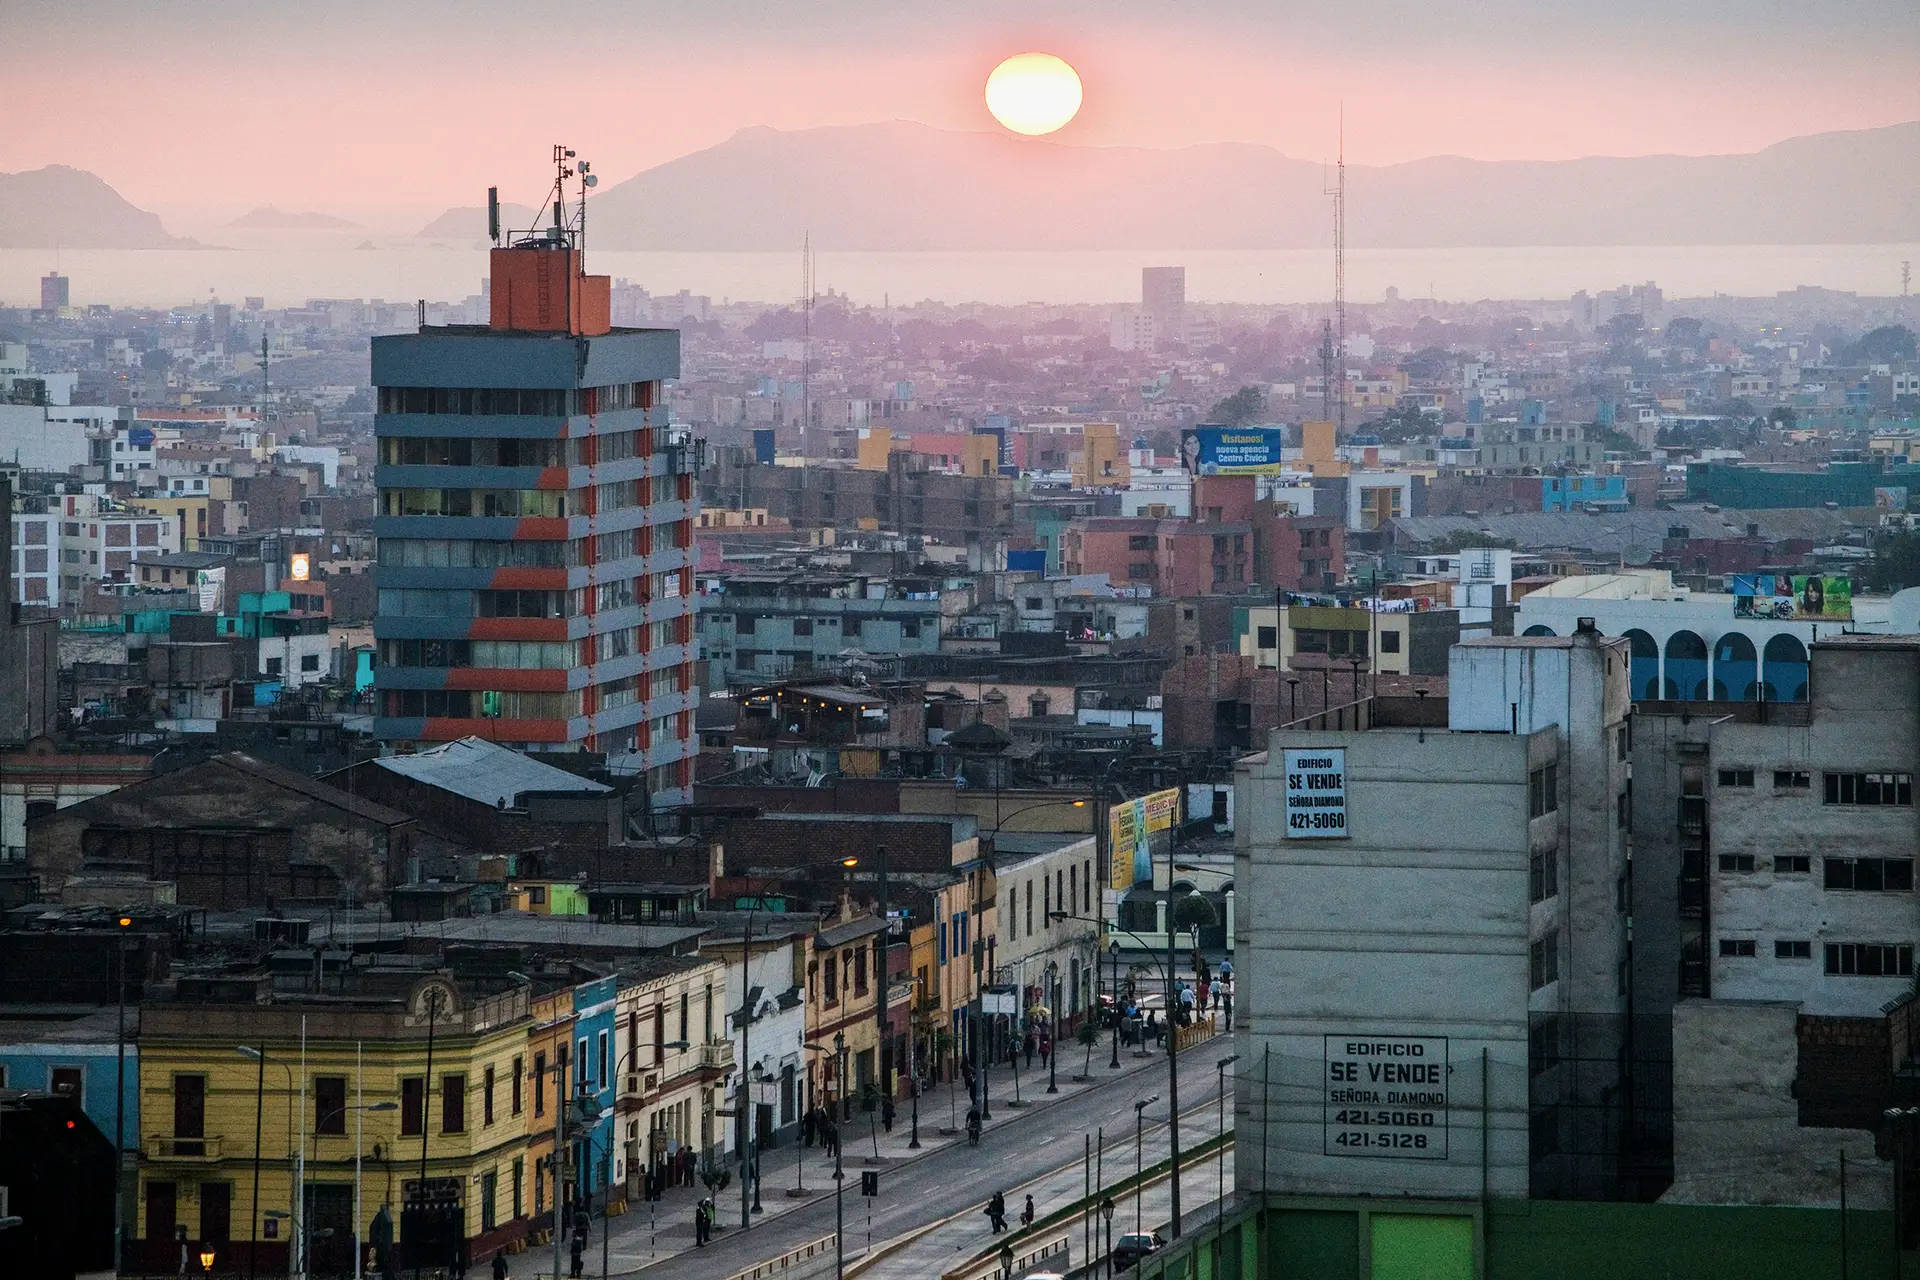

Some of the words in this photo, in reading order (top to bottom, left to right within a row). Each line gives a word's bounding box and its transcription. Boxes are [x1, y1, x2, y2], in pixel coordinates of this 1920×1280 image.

[1216, 446, 1239, 454] nueva
[1240, 445, 1270, 455] agencia
[1218, 454, 1243, 463] Centro
[1297, 758, 1333, 768] EDIFICIO
[1289, 774, 1302, 789] SE
[1307, 774, 1342, 789] VENDE
[1289, 795, 1313, 807] SEÑORA
[1314, 796, 1344, 807] DIAMOND
[1290, 813, 1344, 828] 421-5060
[1346, 1043, 1424, 1056] EDIFICIO
[1331, 1062, 1358, 1081] SE
[1368, 1062, 1440, 1083] VENDE
[1331, 1088, 1380, 1103] SEÑORA
[1388, 1091, 1444, 1104] DIAMOND
[1336, 1110, 1434, 1126] 421-5060
[1335, 1132, 1428, 1148] 421-5128
